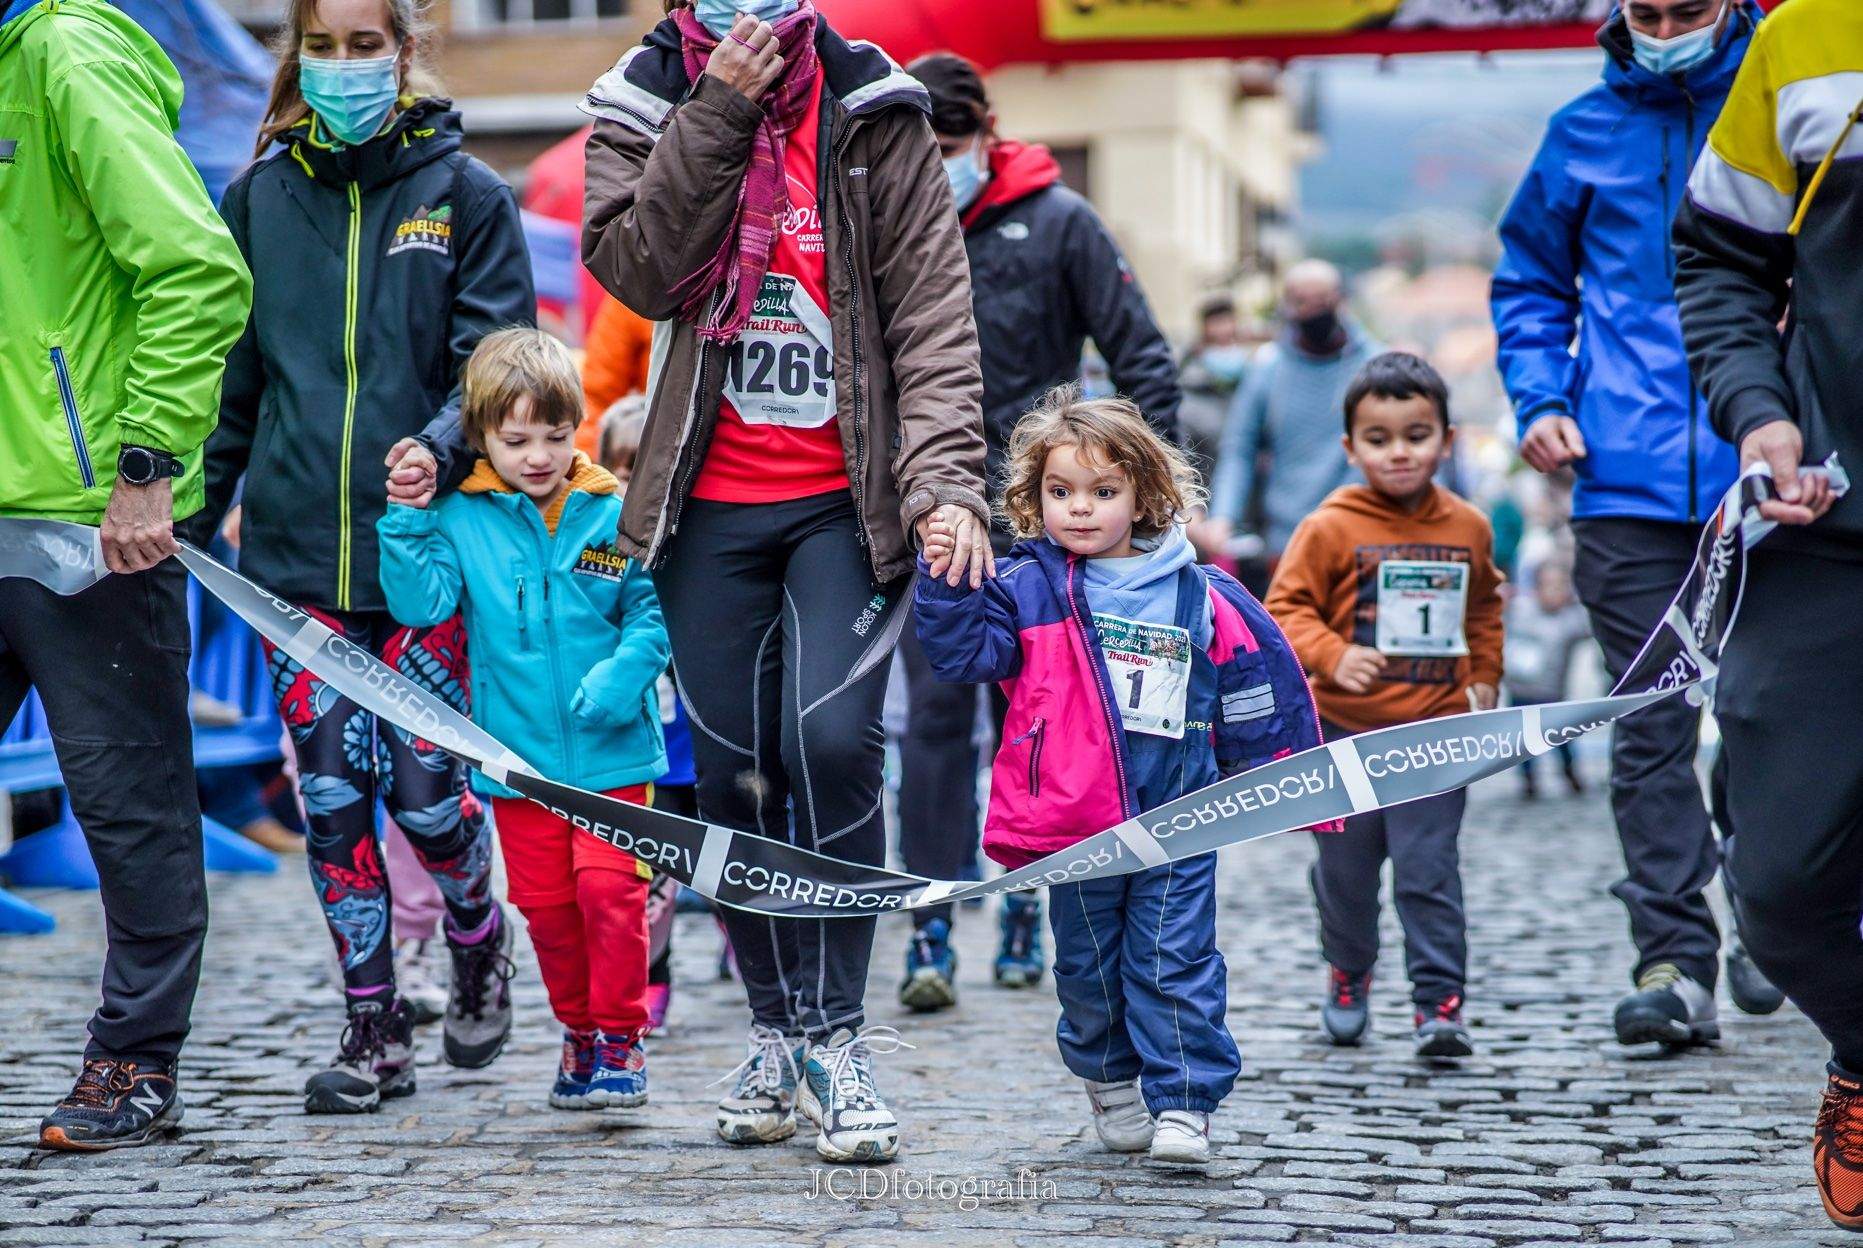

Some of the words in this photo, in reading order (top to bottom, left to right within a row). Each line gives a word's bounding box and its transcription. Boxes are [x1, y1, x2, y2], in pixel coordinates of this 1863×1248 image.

[581, 549, 626, 571] GRAELLSIA
[851, 608, 870, 633] SPORT
[1093, 620, 1127, 634] CARRERA
[1138, 629, 1172, 640] NAVIDAD
[1417, 602, 1431, 635] 1
[1126, 669, 1145, 709] 1
